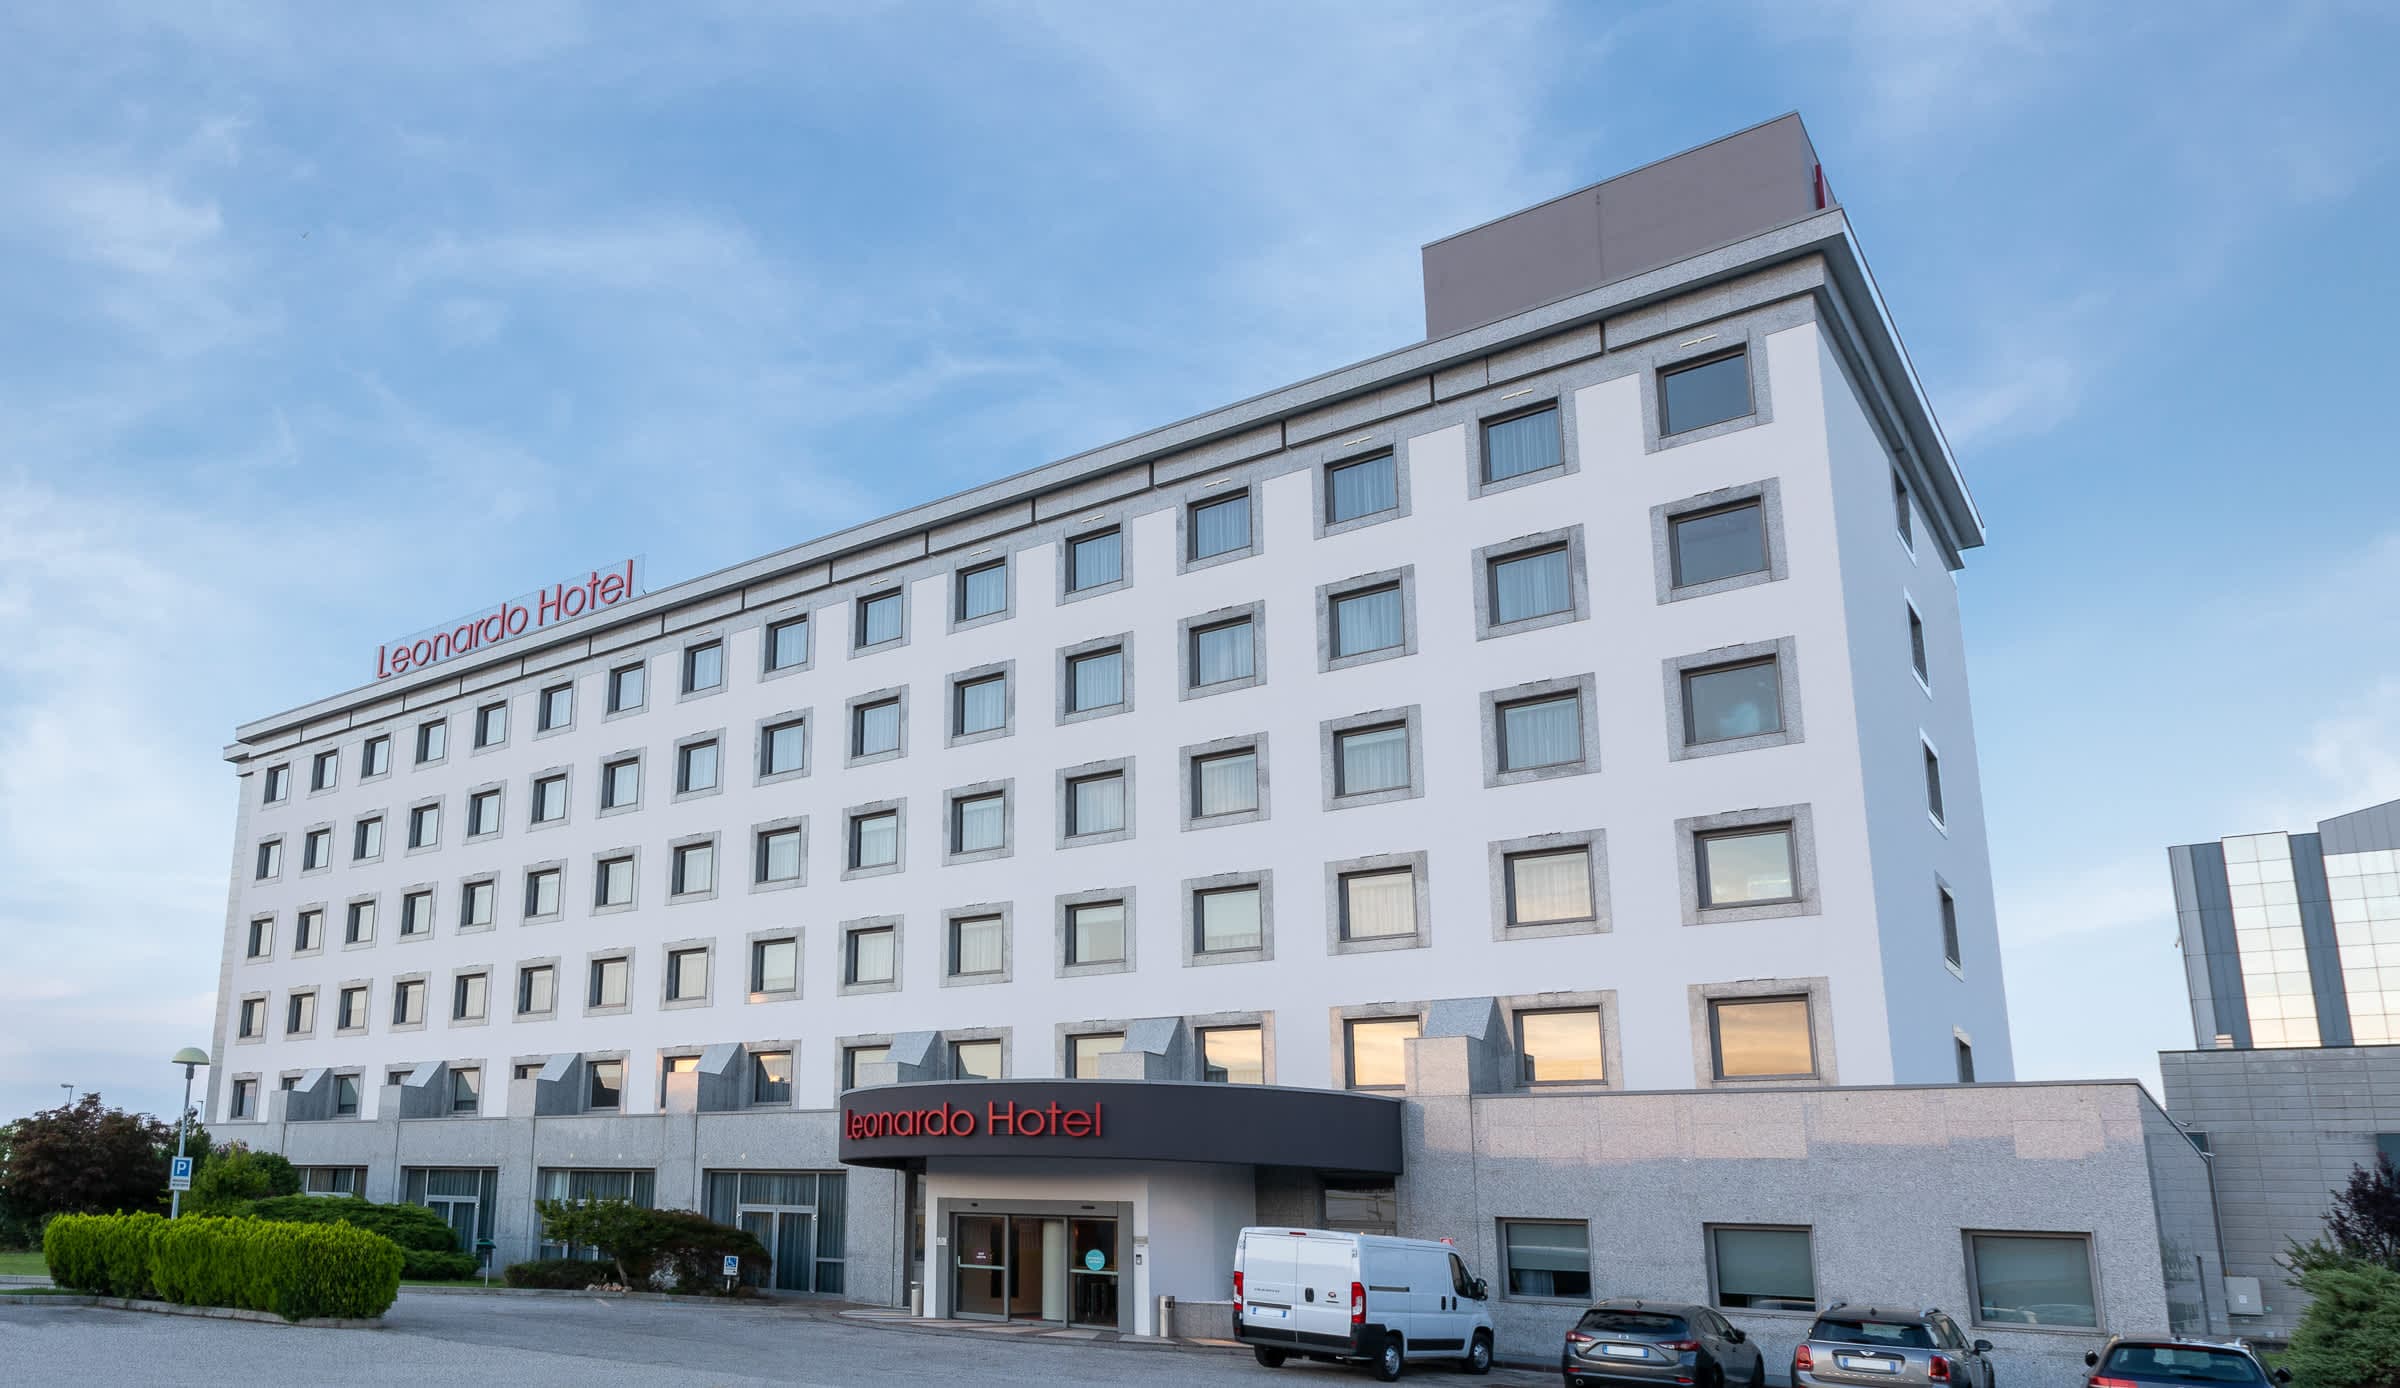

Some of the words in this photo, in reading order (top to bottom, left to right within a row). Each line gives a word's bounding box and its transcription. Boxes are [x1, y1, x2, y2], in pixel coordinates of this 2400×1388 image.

[377, 602, 528, 678] Leonardo
[537, 559, 634, 626] Hotel
[846, 1102, 975, 1138] Leonardo
[988, 1101, 1102, 1137] Hotel
[177, 1161, 187, 1174] P
